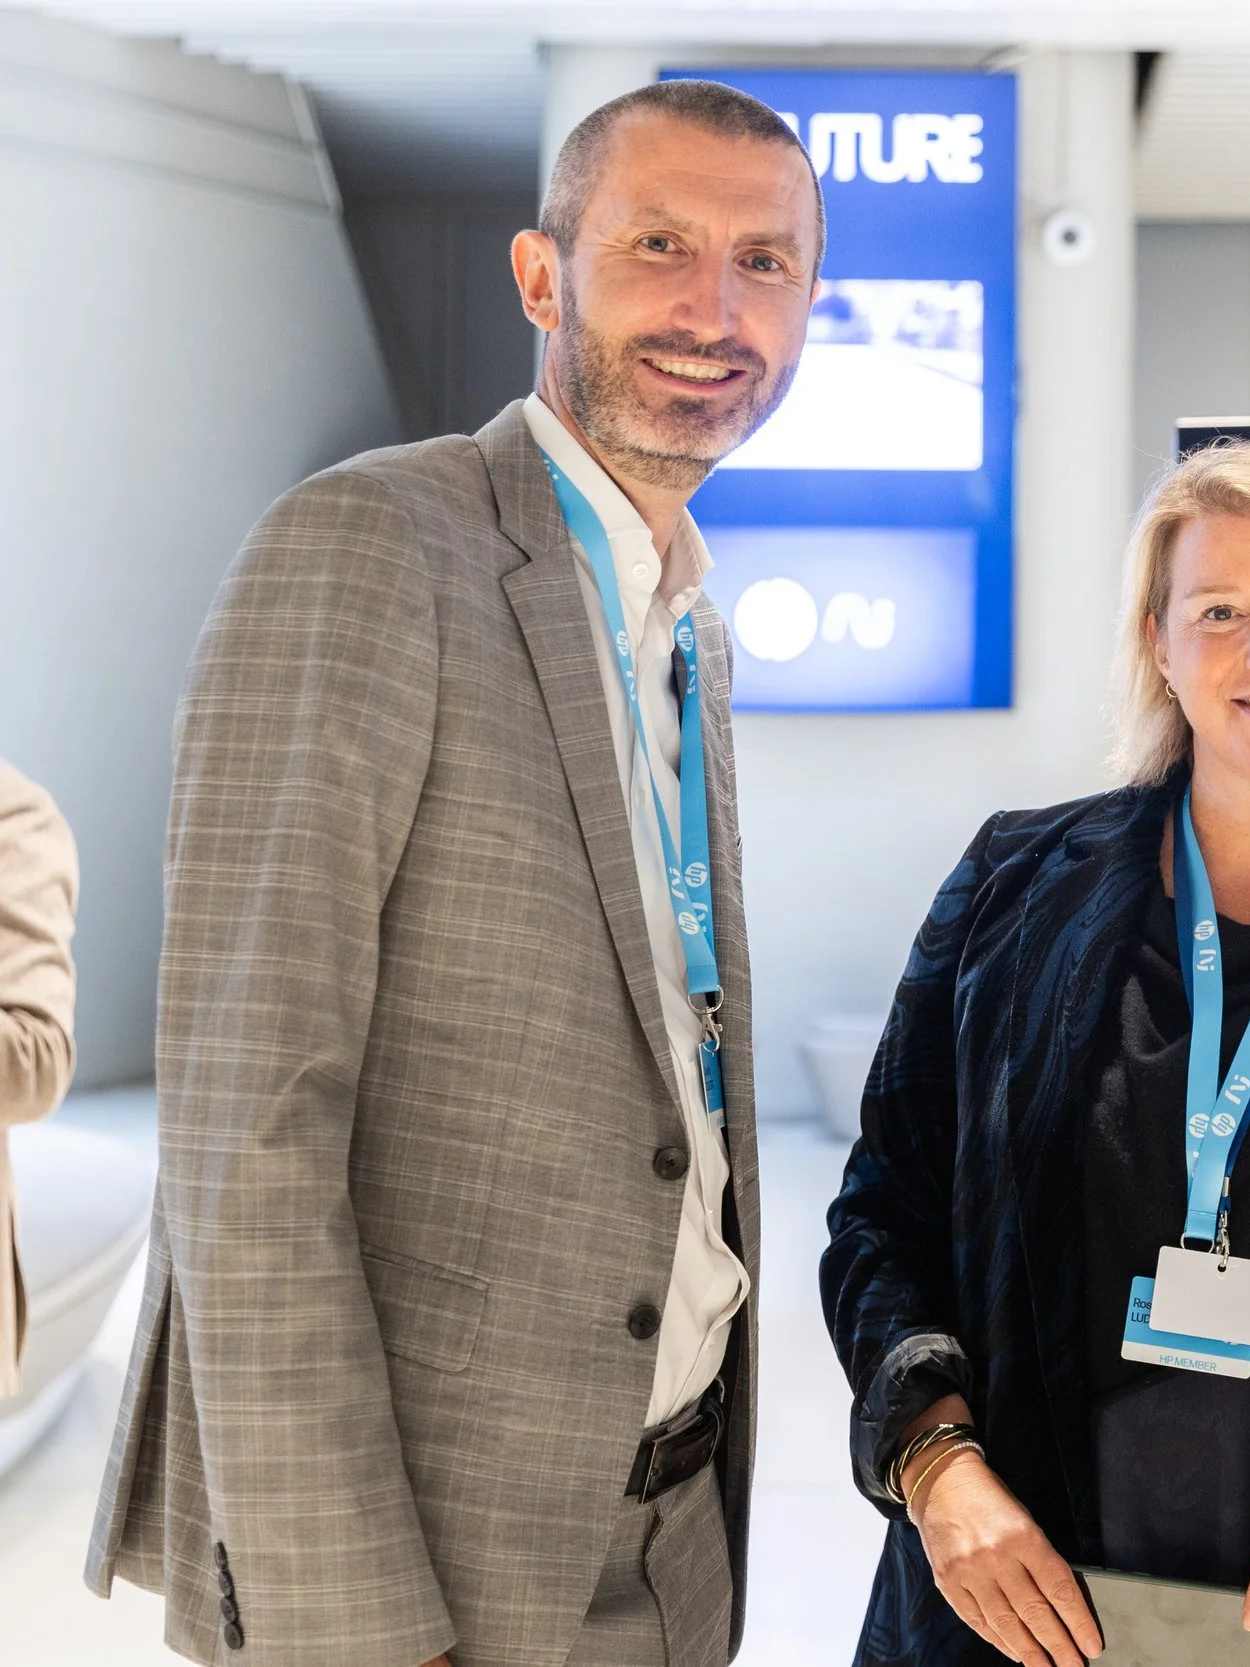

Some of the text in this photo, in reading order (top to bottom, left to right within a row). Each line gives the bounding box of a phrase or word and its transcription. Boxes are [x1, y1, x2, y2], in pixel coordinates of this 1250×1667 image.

[684, 863, 707, 886] hp
[679, 912, 699, 934] hp
[1194, 921, 1215, 939] hp
[1211, 1114, 1235, 1135] hp
[1132, 1297, 1152, 1310] Ros
[1159, 1354, 1217, 1372] HP MEMBER
